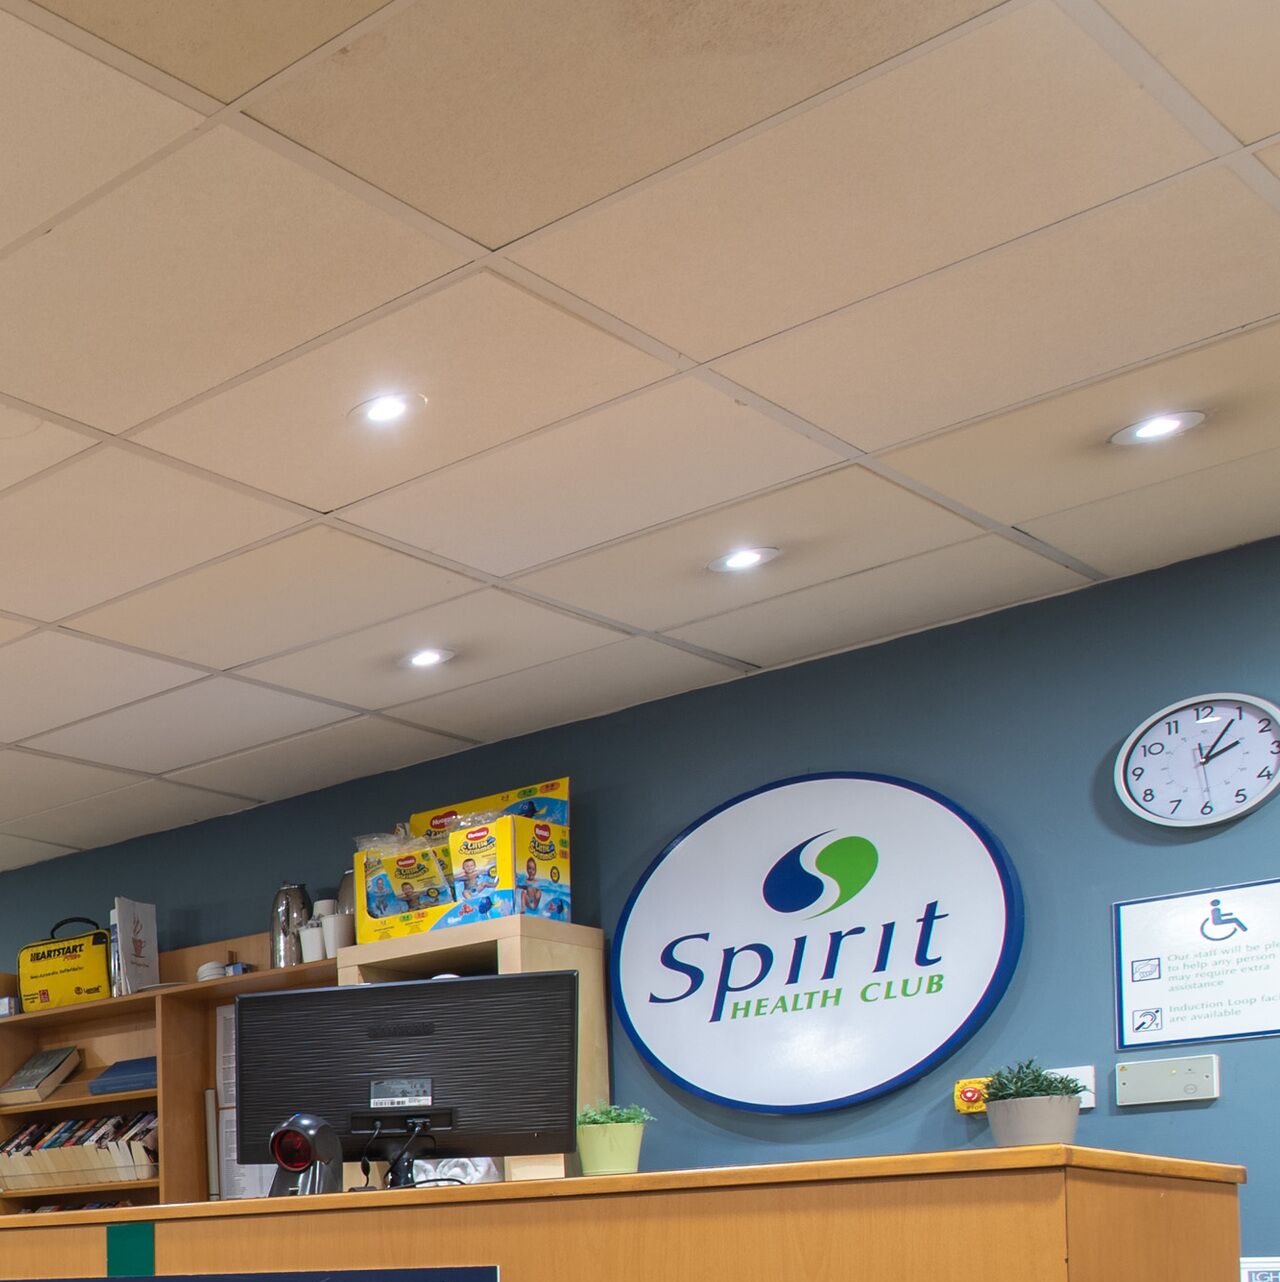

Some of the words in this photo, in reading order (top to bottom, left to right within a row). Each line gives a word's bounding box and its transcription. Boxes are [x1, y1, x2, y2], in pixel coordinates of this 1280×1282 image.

[1193, 705, 1214, 721] 12
[1235, 705, 1243, 720] 1
[1165, 720, 1179, 735] 11
[1258, 718, 1272, 734] 2
[1141, 742, 1165, 757] 10
[1132, 767, 1144, 781] 9
[1256, 765, 1272, 780] 4
[1142, 788, 1155, 802] 8
[1234, 788, 1247, 803] 5
[1169, 799, 1182, 815] 7
[1200, 801, 1214, 815] 6
[31, 944, 85, 962] HEARTSTART
[1167, 953, 1189, 961] Our
[1194, 948, 1217, 958] staff
[1221, 945, 1241, 955] will
[1245, 943, 1260, 951] be
[648, 900, 950, 1023] Spirit
[1183, 961, 1208, 971] help
[1211, 958, 1232, 967] any
[1236, 953, 1276, 967] person
[1168, 974, 1191, 983] may
[1195, 967, 1237, 979] require
[1239, 964, 1270, 972] extra
[1167, 979, 1225, 993] assistance
[730, 987, 842, 1020] HEALTH
[859, 974, 944, 1003] CLUB
[1169, 1001, 1223, 1013] Induction
[1228, 996, 1257, 1007] Loop
[1169, 1014, 1188, 1023] are
[1189, 1008, 1242, 1022] available
